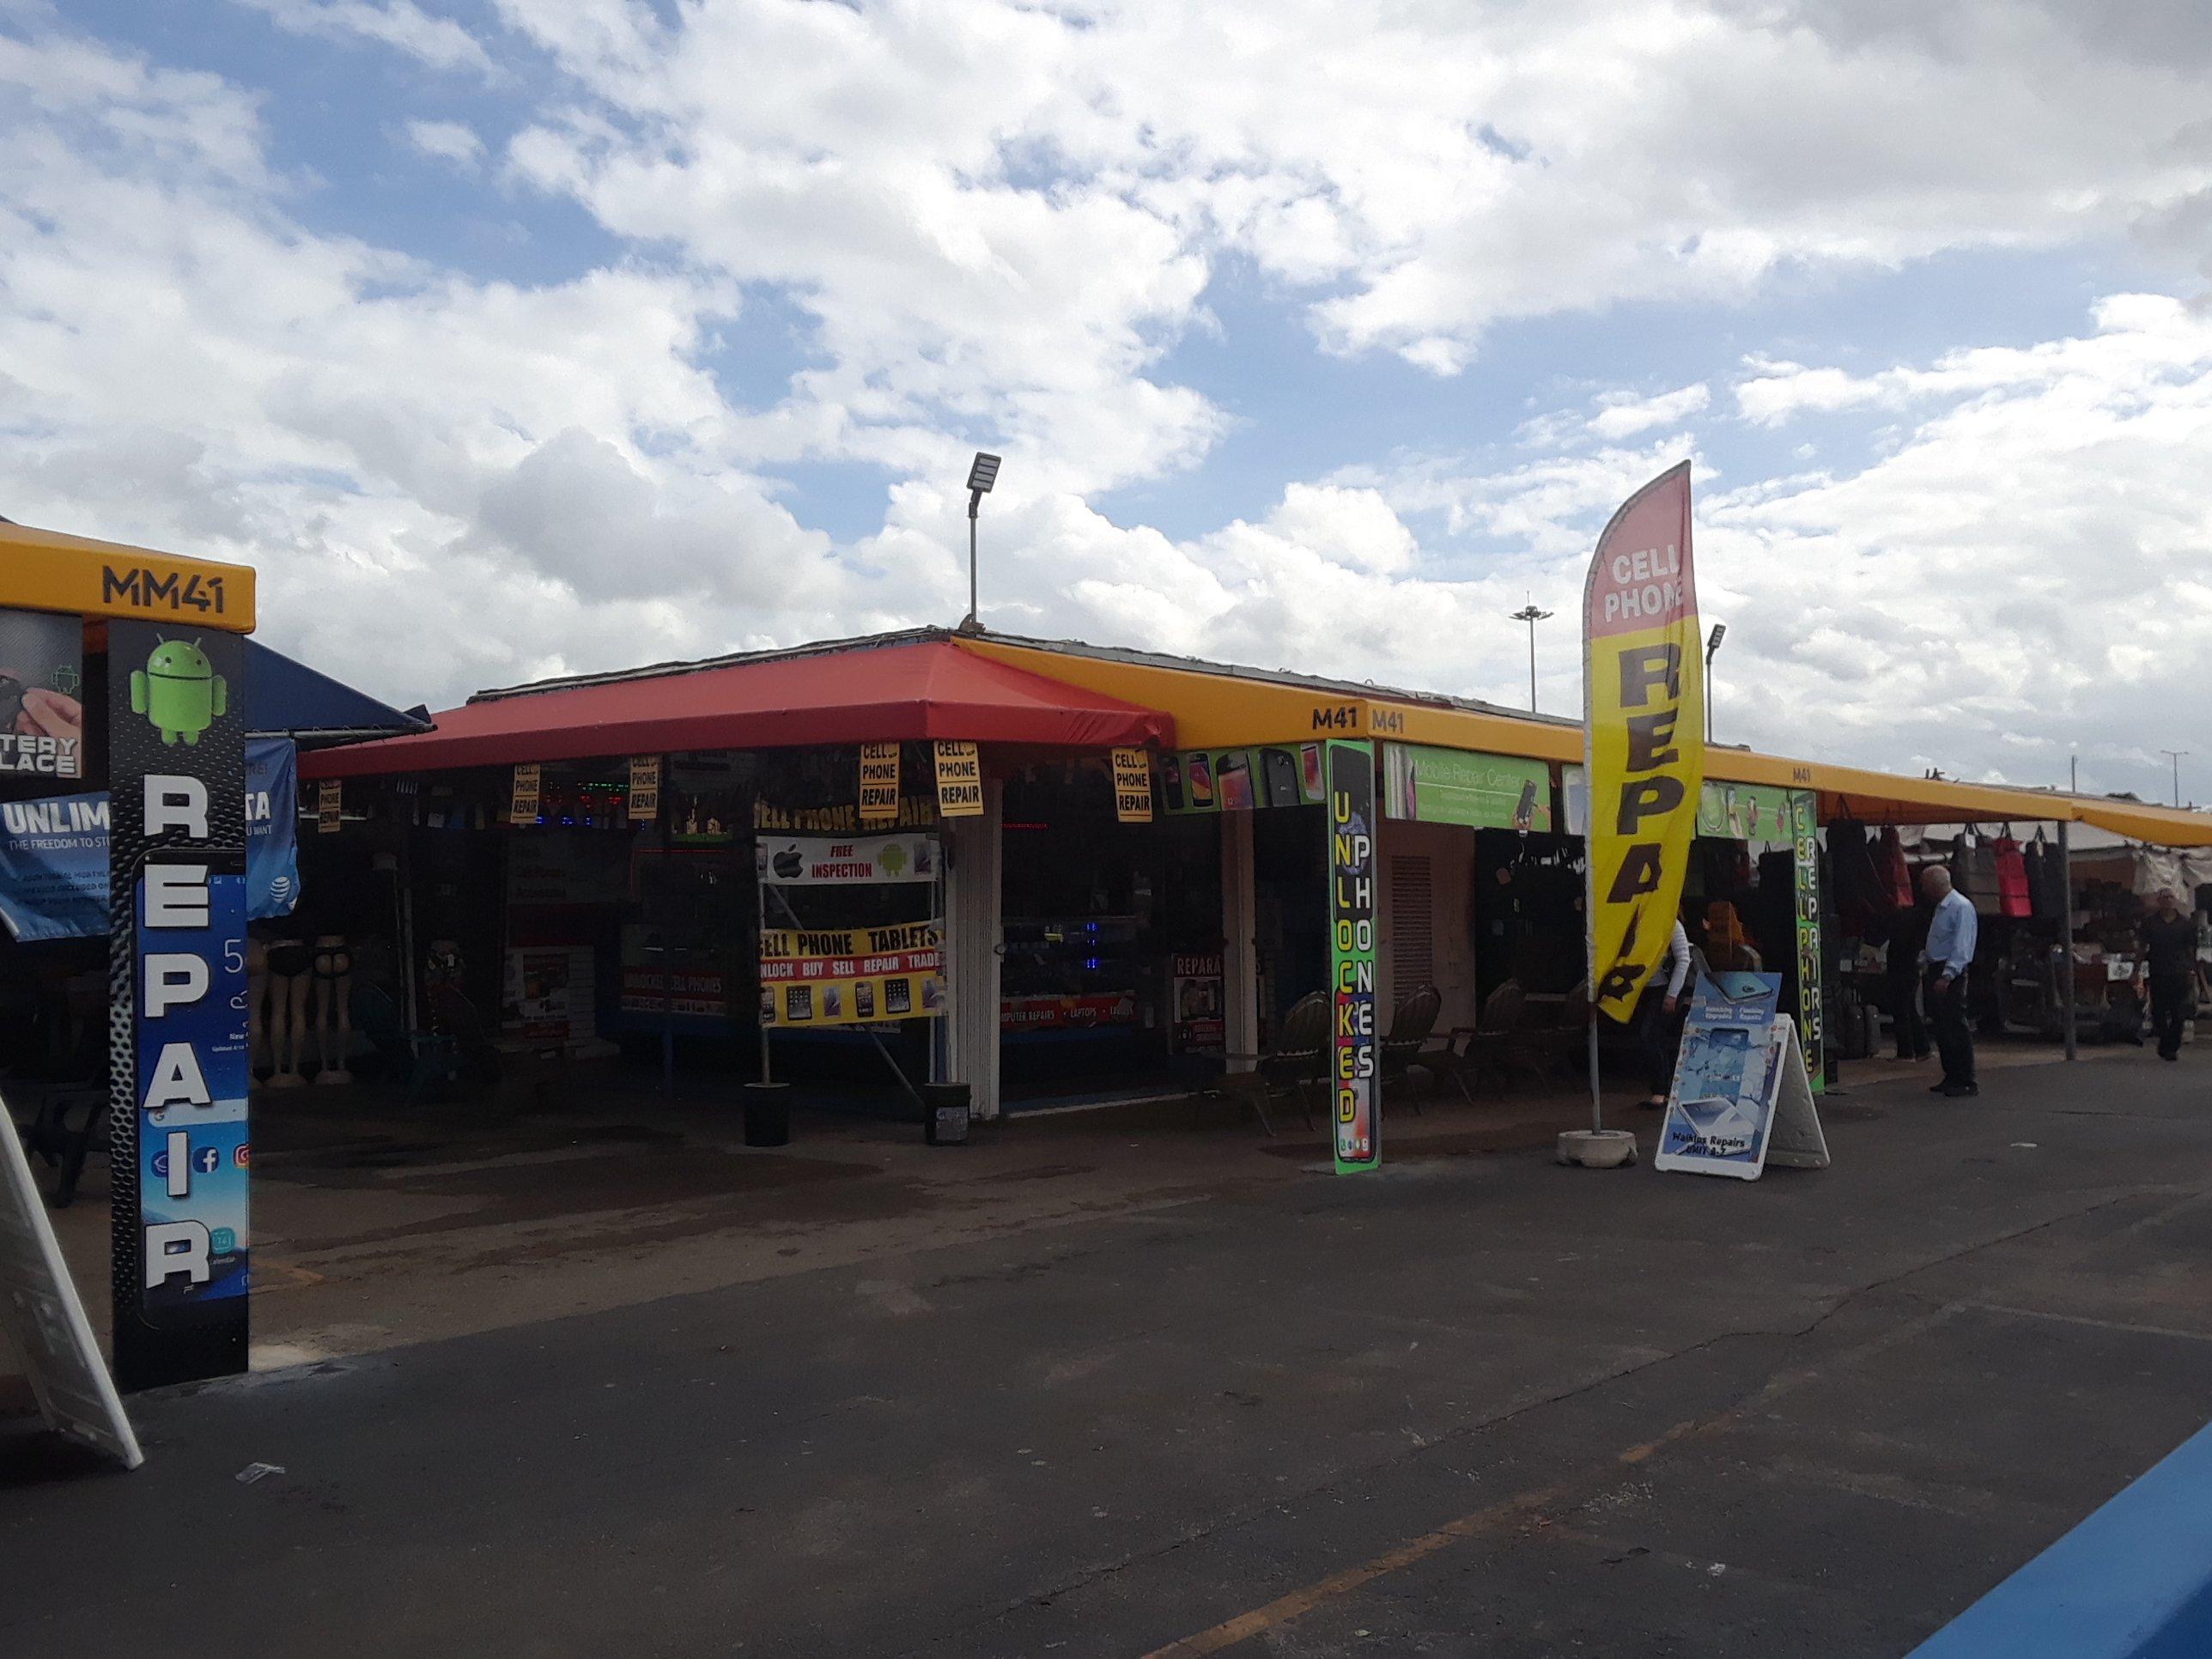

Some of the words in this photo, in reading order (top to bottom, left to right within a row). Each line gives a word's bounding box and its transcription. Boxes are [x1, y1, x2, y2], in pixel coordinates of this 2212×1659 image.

[1613, 544, 1680, 585] CELL
[102, 563, 224, 613] MM41
[1312, 706, 1357, 730] M41
[1372, 708, 1404, 734] M41
[0, 734, 77, 756] TERY
[864, 744, 886, 759] CELL
[938, 741, 964, 757] CELL
[0, 753, 76, 774] LACE
[1115, 754, 1138, 768] CELL
[862, 763, 896, 779] PHONE
[939, 762, 976, 777] PHONE
[515, 780, 538, 792] PHONE
[632, 772, 656, 785] PHONE
[1116, 773, 1147, 787] PHONE
[631, 793, 656, 809] REPAIR
[861, 788, 896, 805] REPAIR
[941, 786, 979, 804] REPAIR
[1119, 795, 1150, 811] REPAIR
[3, 801, 110, 835] UNLIM
[245, 791, 270, 820] TA
[514, 799, 537, 813] REPAIR
[1597, 642, 1685, 1004] REPAIR
[9, 839, 28, 852] THE
[30, 838, 78, 850] FREEDOM
[79, 836, 94, 848] TO
[830, 844, 854, 857] FREE
[811, 862, 872, 878] INSPECTION
[797, 933, 854, 957] PHONE
[867, 925, 939, 953] TABLETS
[1334, 791, 1355, 1123] UNLOCKED
[1354, 835, 1374, 1078] PHONES
[761, 963, 794, 979] NLOCK
[802, 961, 824, 977] BUY
[832, 959, 855, 975] SELL
[863, 956, 900, 973] REPAIR
[143, 775, 211, 1288] REPAIR
[1710, 1135, 1746, 1148] Repairs
